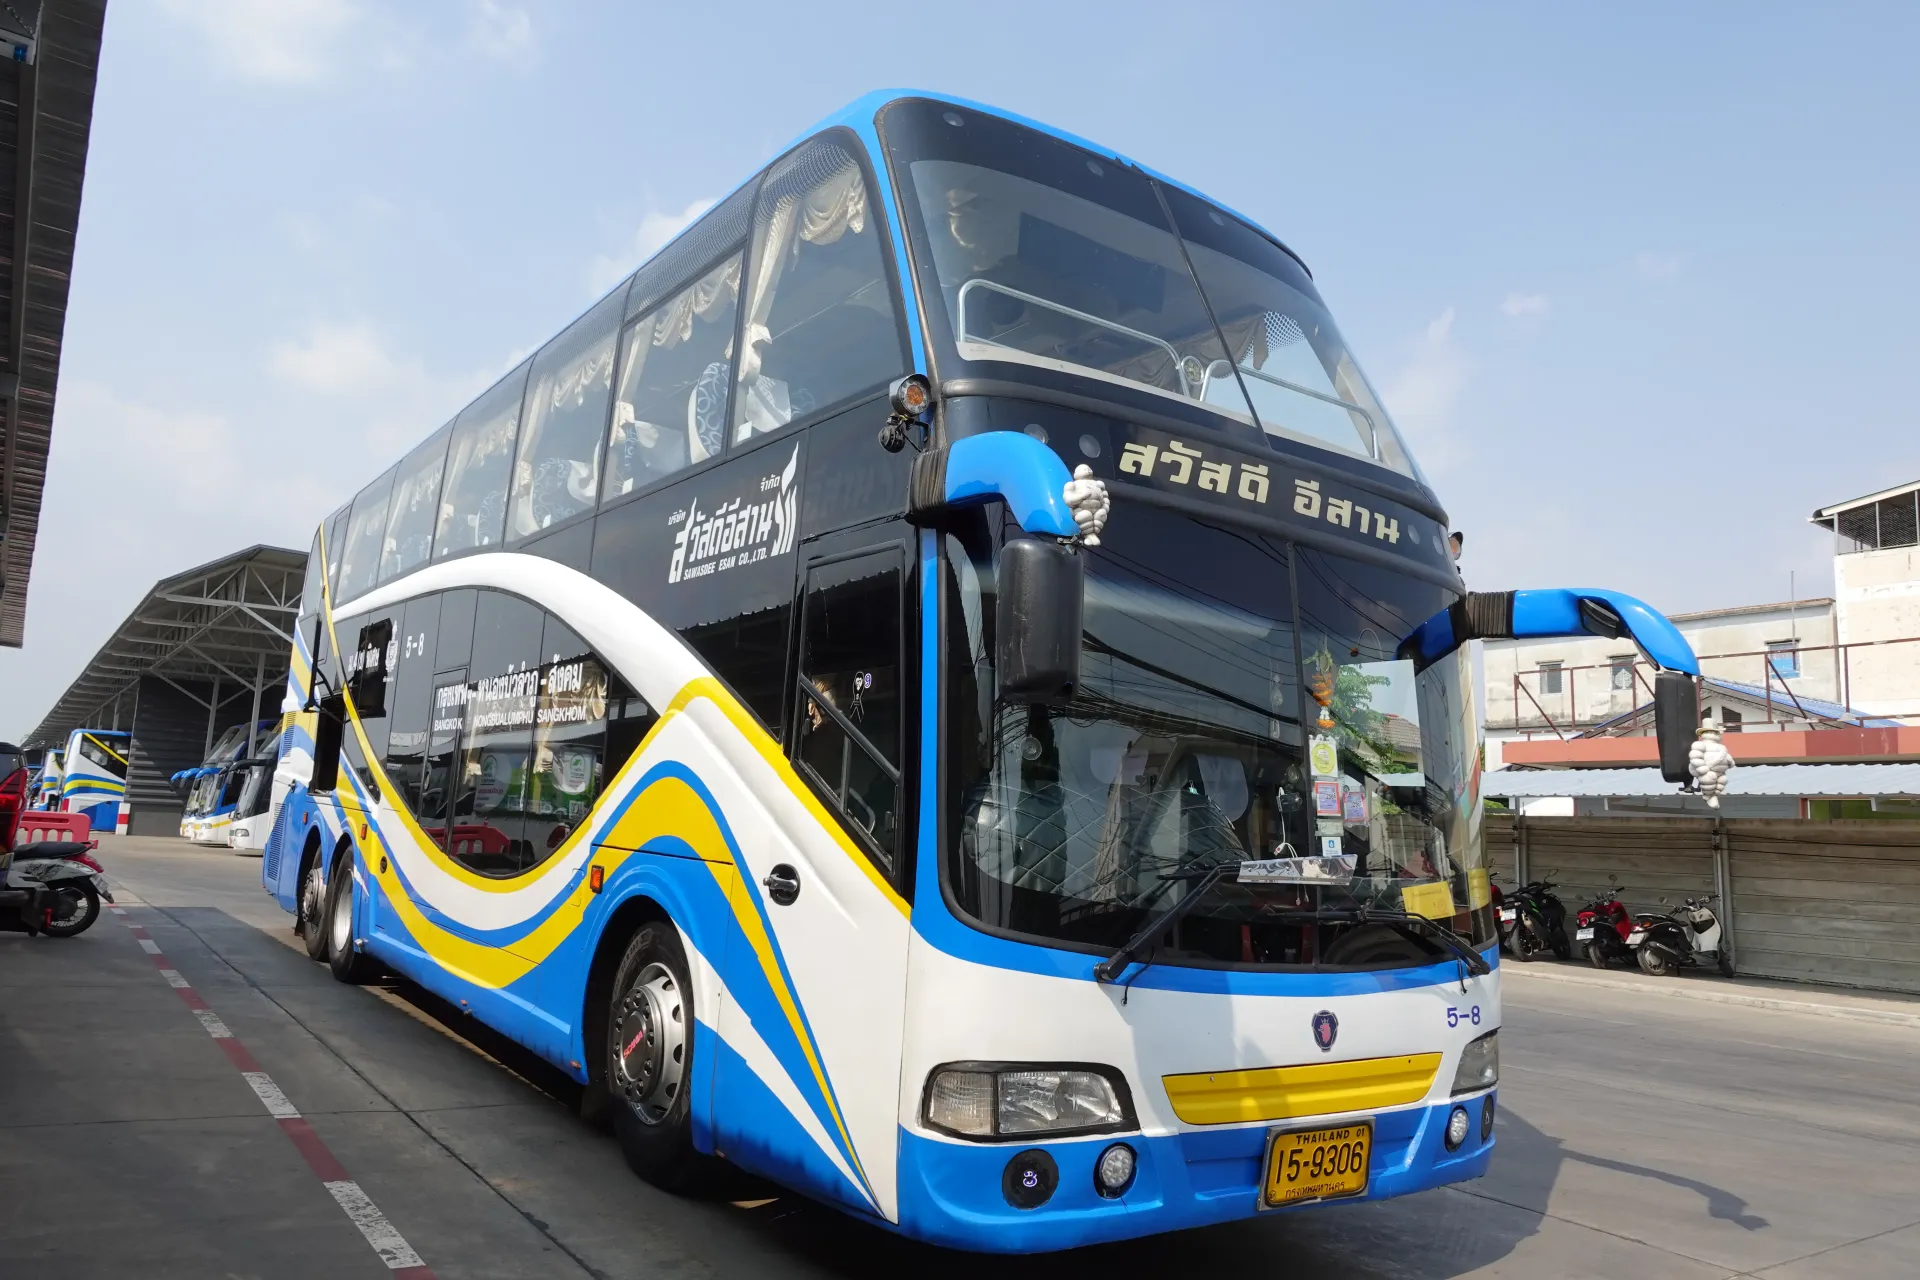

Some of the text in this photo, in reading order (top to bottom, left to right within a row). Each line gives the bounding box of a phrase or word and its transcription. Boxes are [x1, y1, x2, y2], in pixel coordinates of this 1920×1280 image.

[760, 474, 781, 492] จำกัด
[1119, 440, 1400, 544] สวัสดี อีสาน
[684, 562, 716, 580] SAWASDEE
[718, 555, 736, 571] ESAN
[406, 632, 424, 659] 5-8
[537, 705, 586, 723] SANGKHOM
[1447, 1005, 1481, 1028] 5-8
[1296, 1129, 1350, 1145] THAILAND
[1276, 1140, 1364, 1185] 15-9306
